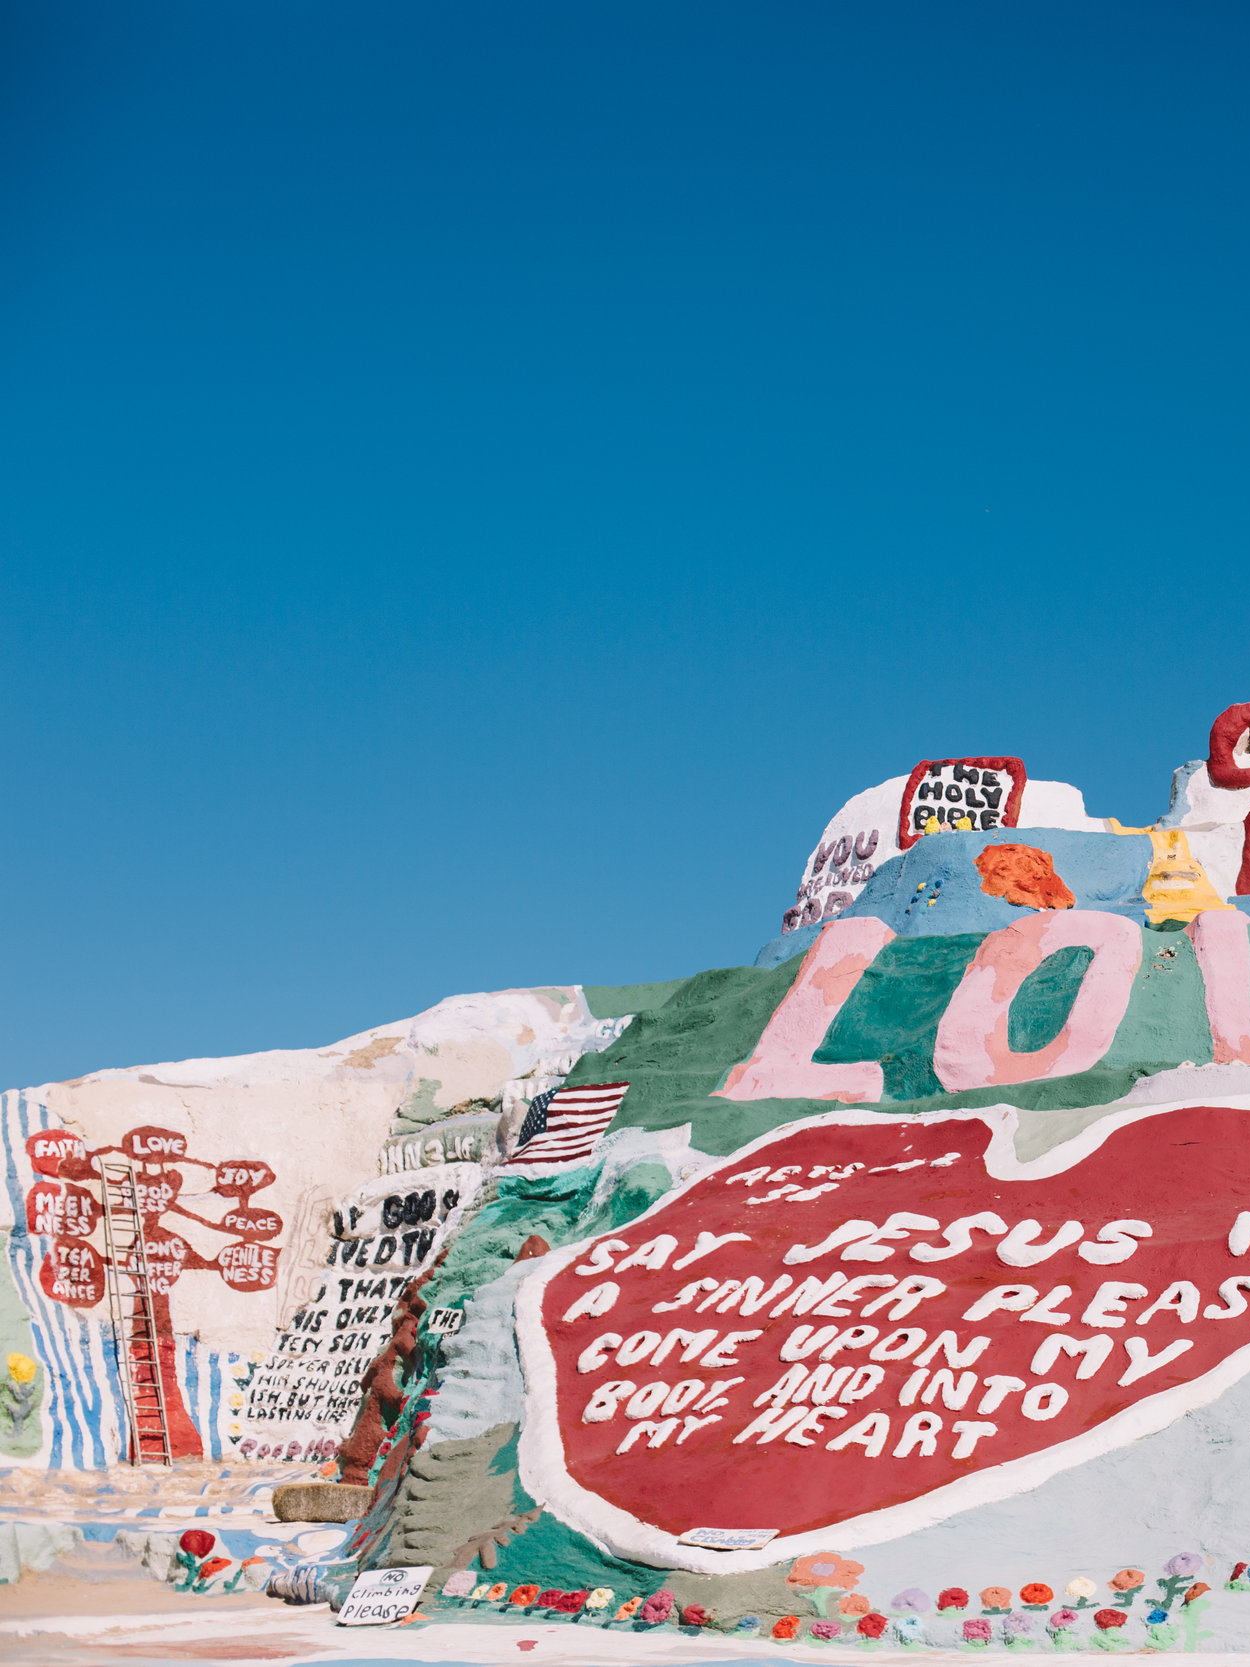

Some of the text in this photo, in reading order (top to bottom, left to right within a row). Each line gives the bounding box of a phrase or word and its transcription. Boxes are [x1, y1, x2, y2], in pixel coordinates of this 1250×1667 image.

[929, 763, 1000, 787] THE
[918, 781, 1003, 809] HOLY
[914, 805, 1000, 831] BIBLE
[814, 829, 879, 873] YOU
[825, 863, 874, 886] LOVED
[782, 891, 854, 935] GOD
[35, 1140, 86, 1160] FAITH
[132, 1135, 184, 1154] LOVE
[218, 1167, 267, 1186] JOY
[121, 1181, 174, 1200] GOOD
[36, 1192, 92, 1218] MEEK
[383, 1189, 437, 1229] GOD
[36, 1216, 91, 1237] NESS
[225, 1215, 278, 1231] PEACE
[575, 1231, 752, 1276] SAY
[783, 1211, 1153, 1268] JESUS
[218, 1243, 275, 1268] GENTLE
[57, 1266, 91, 1282] PER
[224, 1266, 274, 1285] NESS
[52, 1280, 95, 1301] ANCE
[562, 1282, 620, 1323] A
[652, 1271, 947, 1321] SINNER
[336, 1304, 393, 1330] ONLY
[432, 1310, 459, 1328] THE
[329, 1332, 372, 1353] SON
[578, 1325, 1194, 1387] COME UPON MY
[287, 1392, 325, 1407] BUT
[582, 1363, 1069, 1424] BODY AND INTO
[247, 1407, 312, 1421] LASTING
[616, 1407, 998, 1459] MY HEART
[383, 1573, 405, 1583] NO
